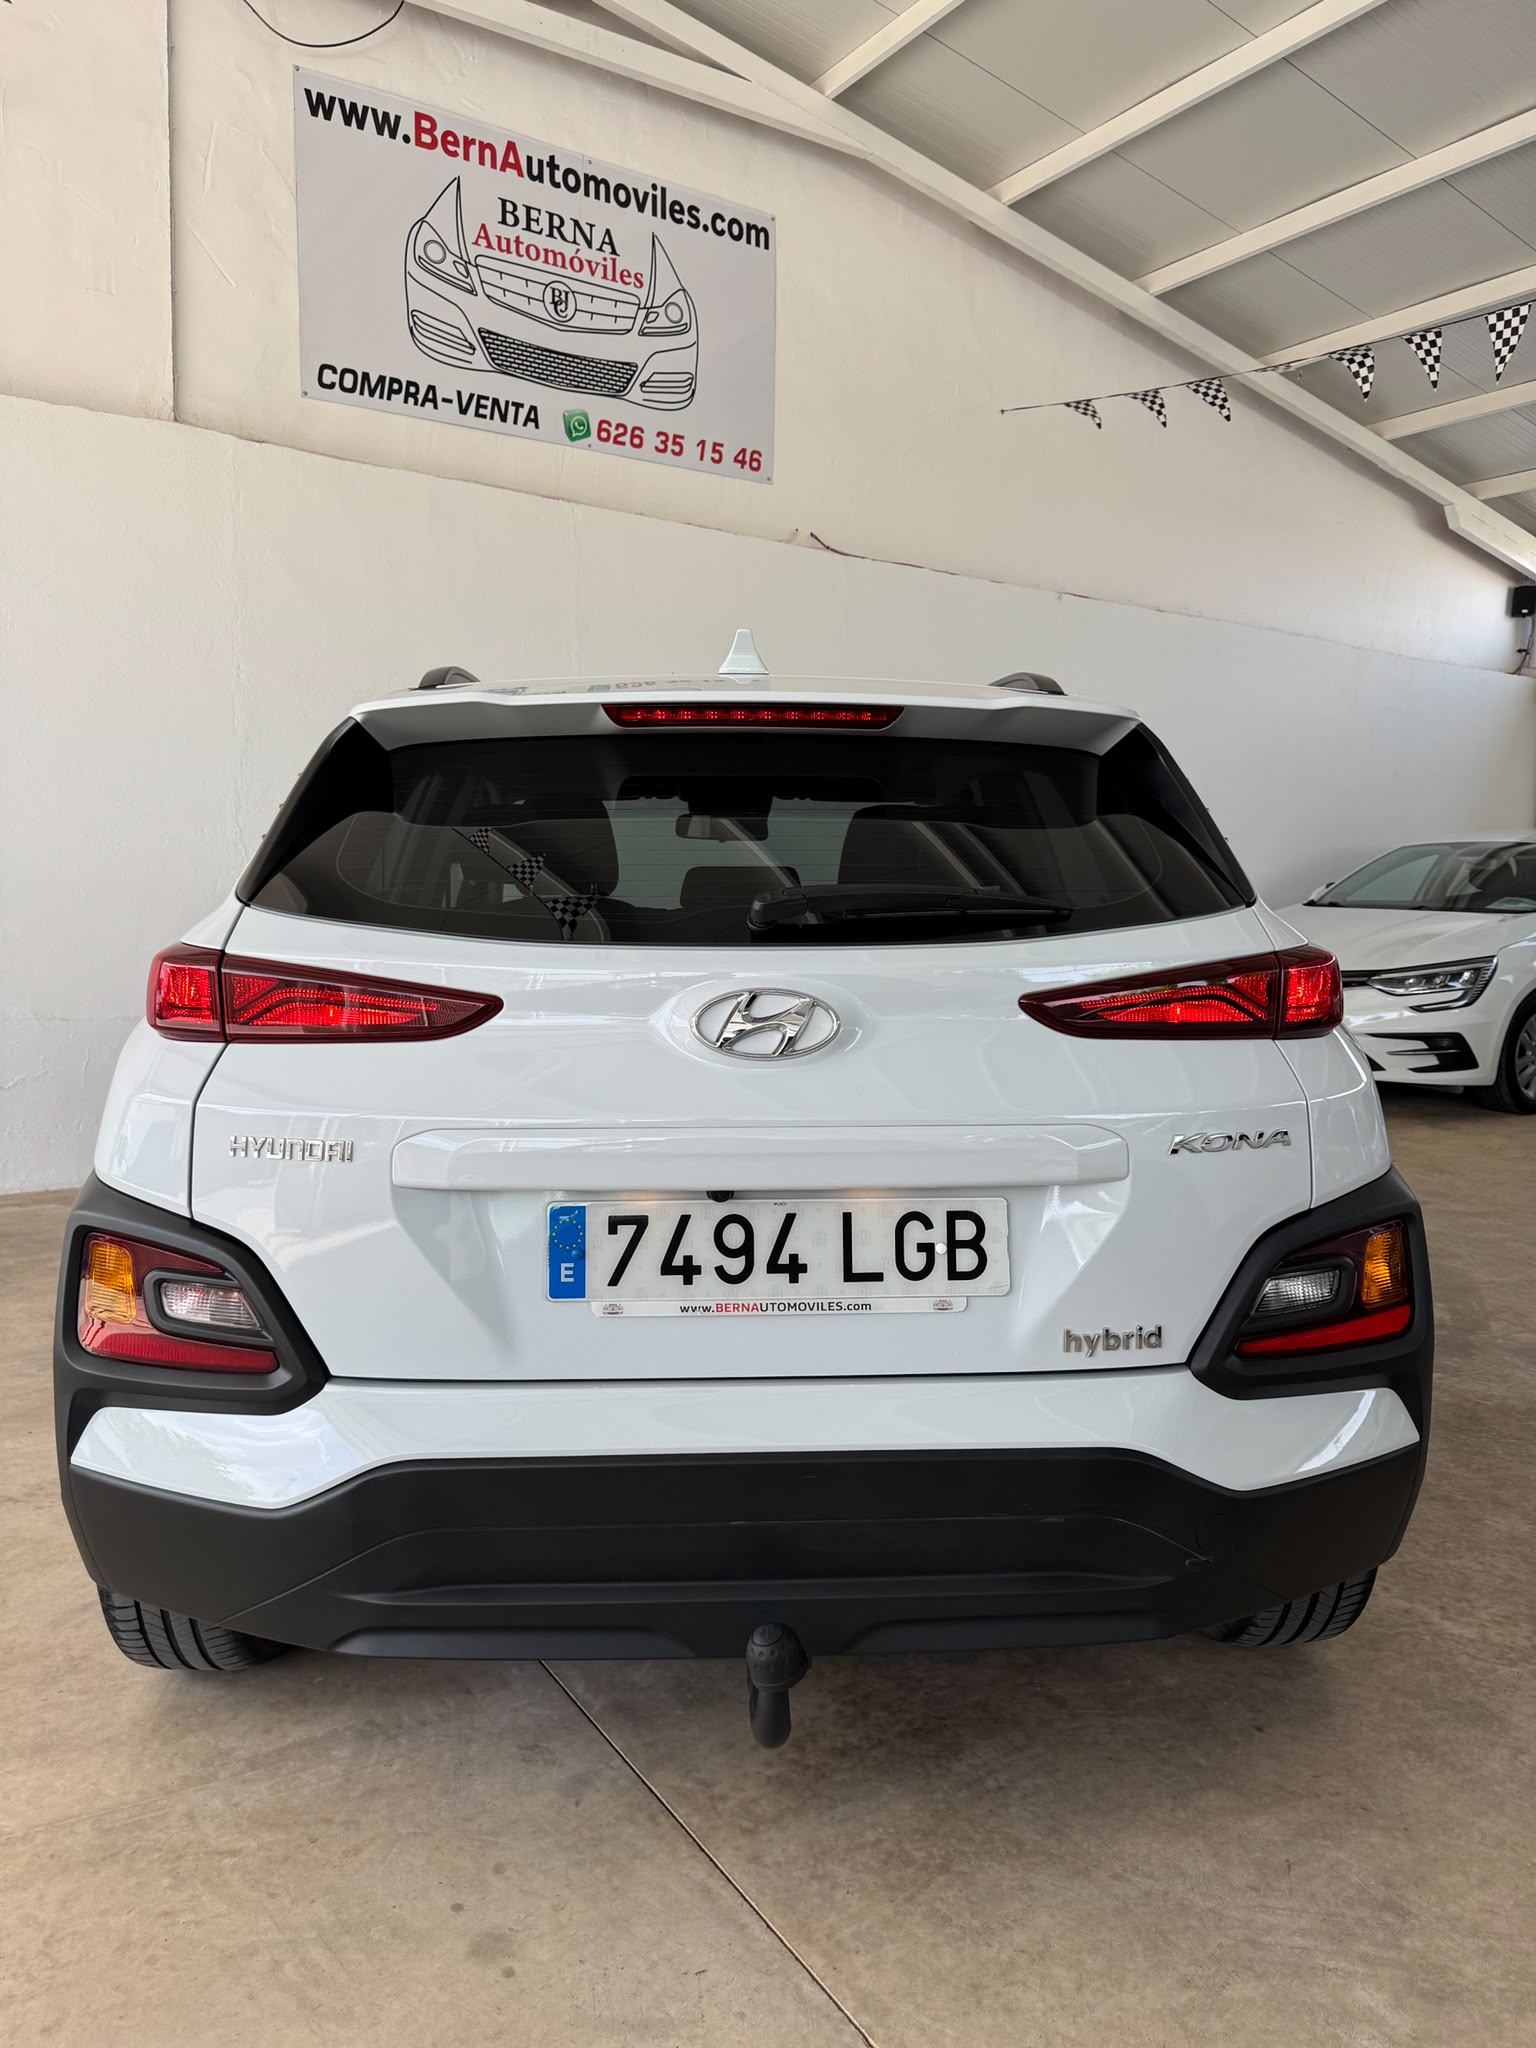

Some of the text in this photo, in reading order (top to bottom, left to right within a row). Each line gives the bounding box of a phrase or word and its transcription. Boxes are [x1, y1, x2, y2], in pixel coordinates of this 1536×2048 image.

[304, 88, 771, 251] www.BernAutomoviles.com
[497, 198, 620, 256] BERNA
[471, 223, 644, 289] Automóviles
[317, 363, 540, 430] COMPRA-VENTA
[596, 419, 762, 472] 626 35 15 46
[229, 1135, 353, 1162] HYUNDAI
[1168, 1128, 1291, 1155] KONA
[560, 1263, 574, 1281] E
[607, 1210, 988, 1287] 7494 LGB
[679, 1300, 872, 1315] www.BERNAUTOMOVILES.com
[1063, 1324, 1162, 1358] hybrid
